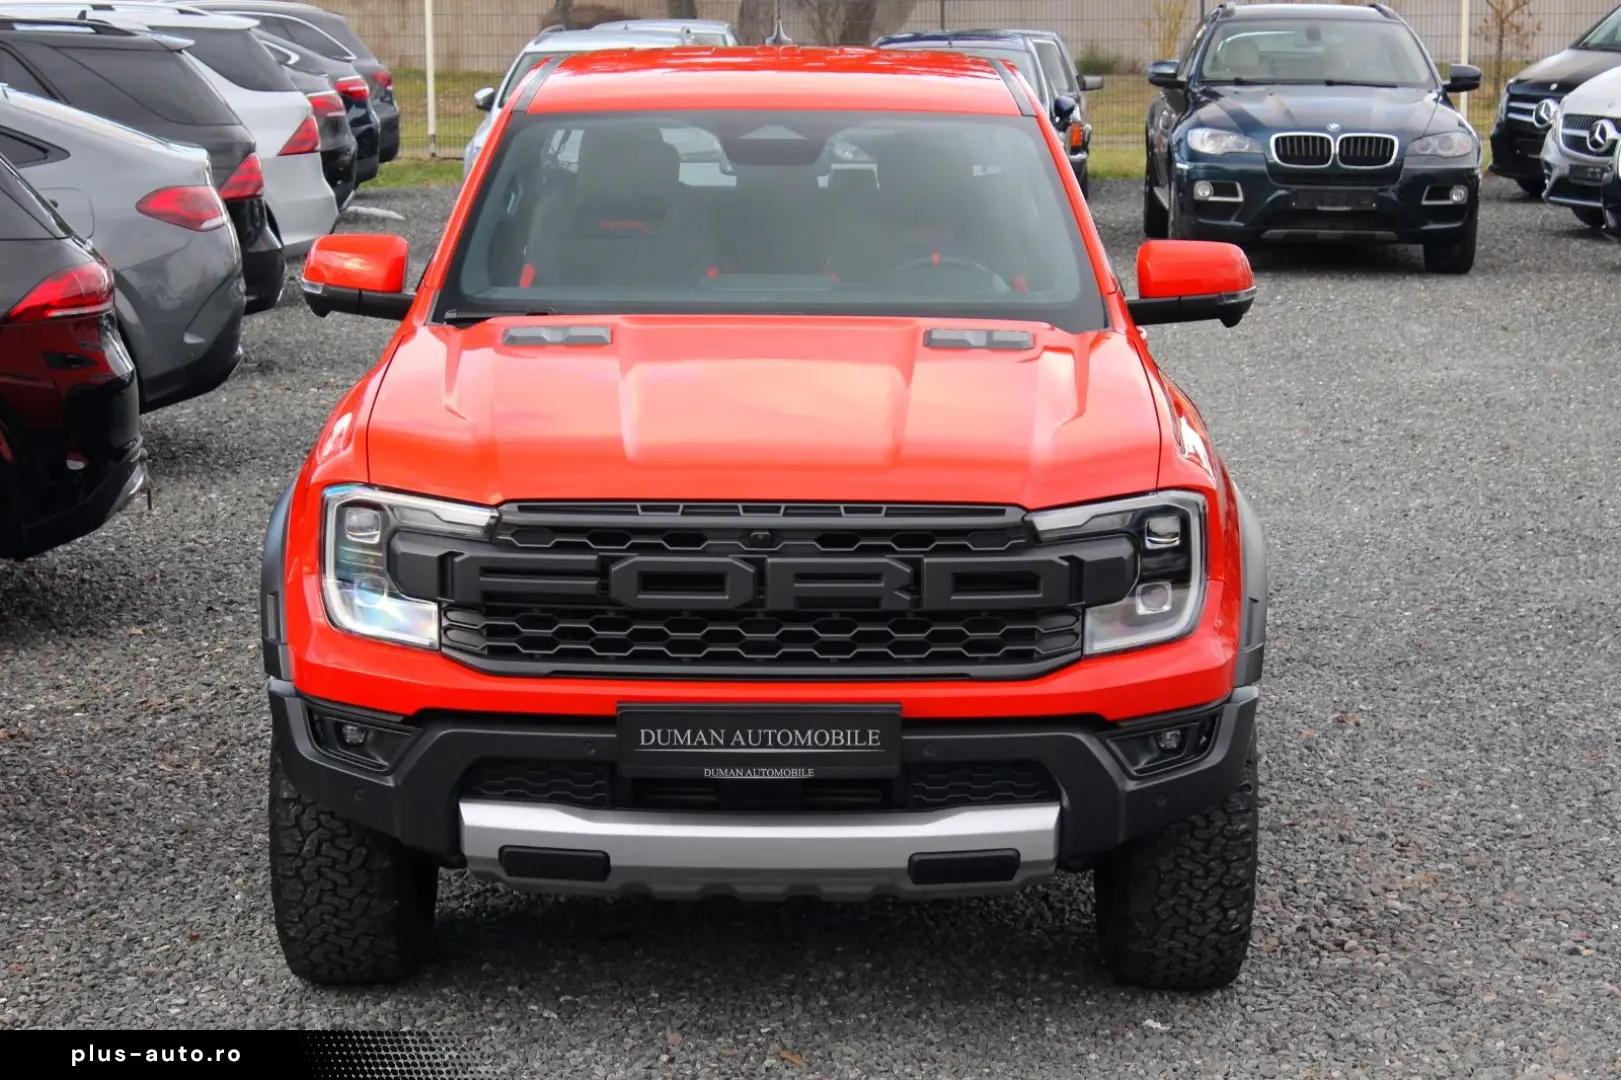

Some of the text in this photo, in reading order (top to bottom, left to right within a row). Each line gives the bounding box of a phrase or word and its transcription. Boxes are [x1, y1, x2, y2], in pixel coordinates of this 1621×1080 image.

[452, 553, 1070, 610] FORD
[639, 728, 881, 746] DUMAN AUTOMOBILE
[703, 768, 815, 778] DUMAN AUTOMOBILE
